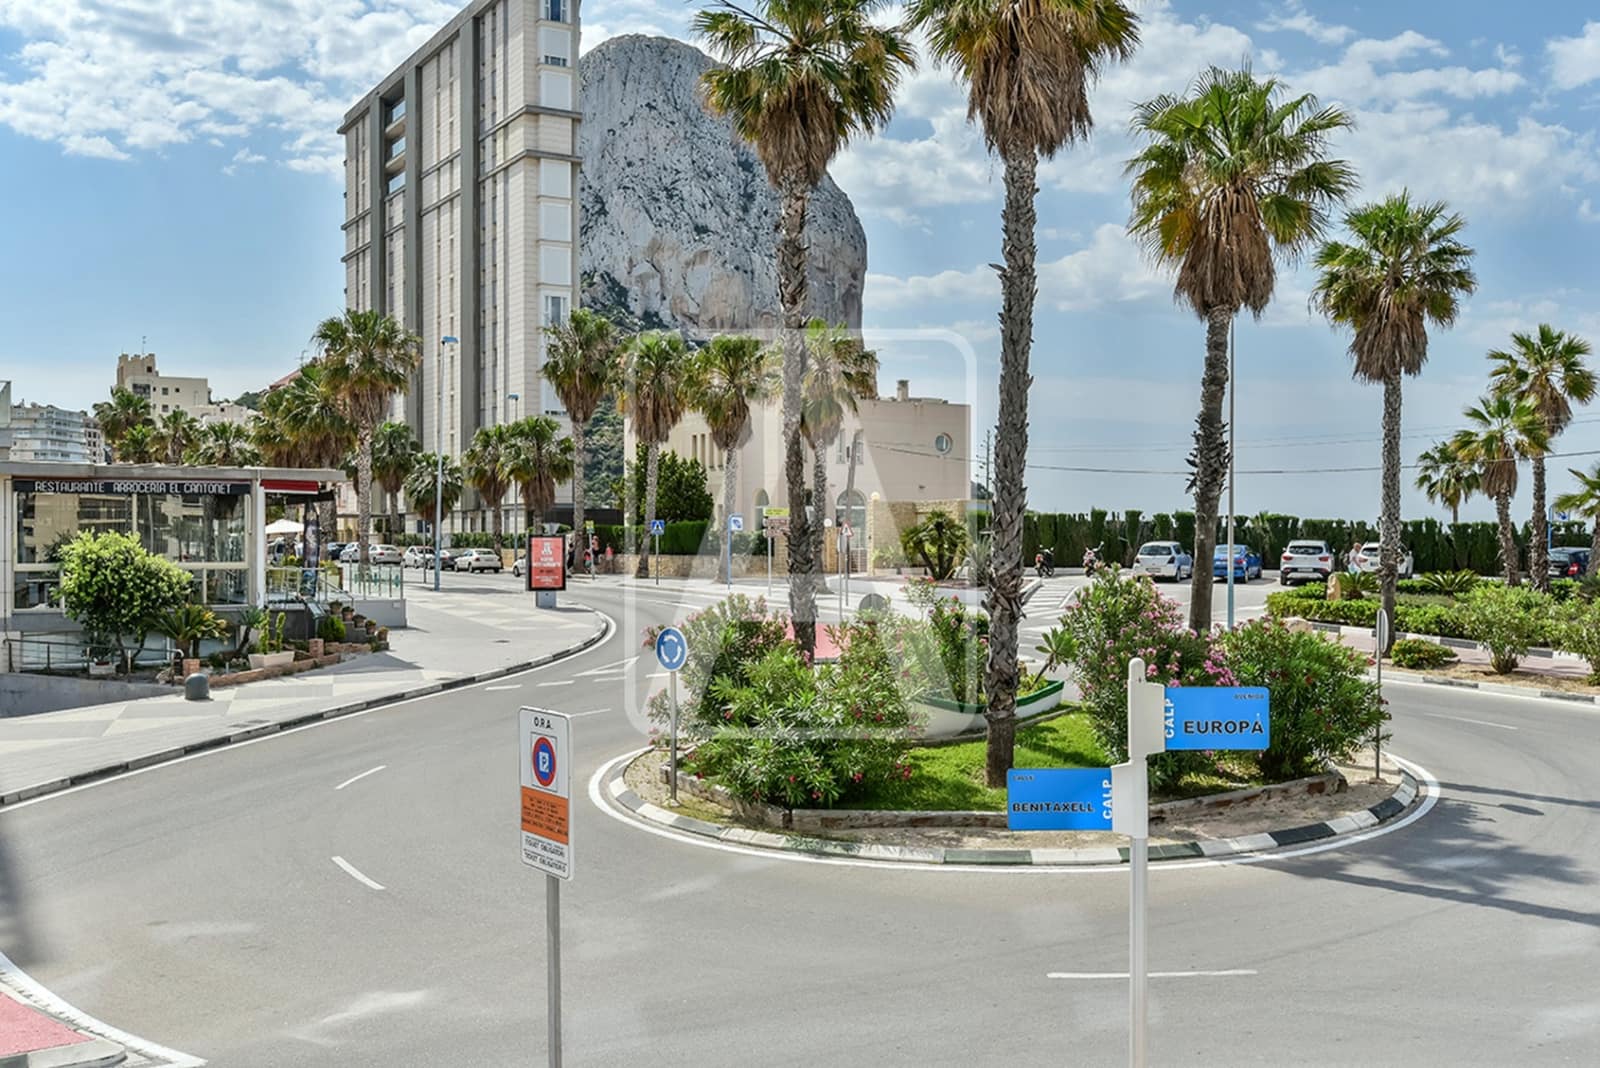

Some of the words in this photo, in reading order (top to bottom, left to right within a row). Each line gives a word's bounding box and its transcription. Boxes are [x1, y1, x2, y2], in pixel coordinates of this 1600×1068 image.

[35, 480, 105, 493] RESTAURANTE
[170, 482, 181, 494] EL
[184, 482, 231, 495] CANTONET
[1165, 698, 1175, 739] CALP
[1184, 720, 1264, 734] EUROPA
[1102, 779, 1112, 820] CALP
[1012, 802, 1094, 813] BENITAXELL
